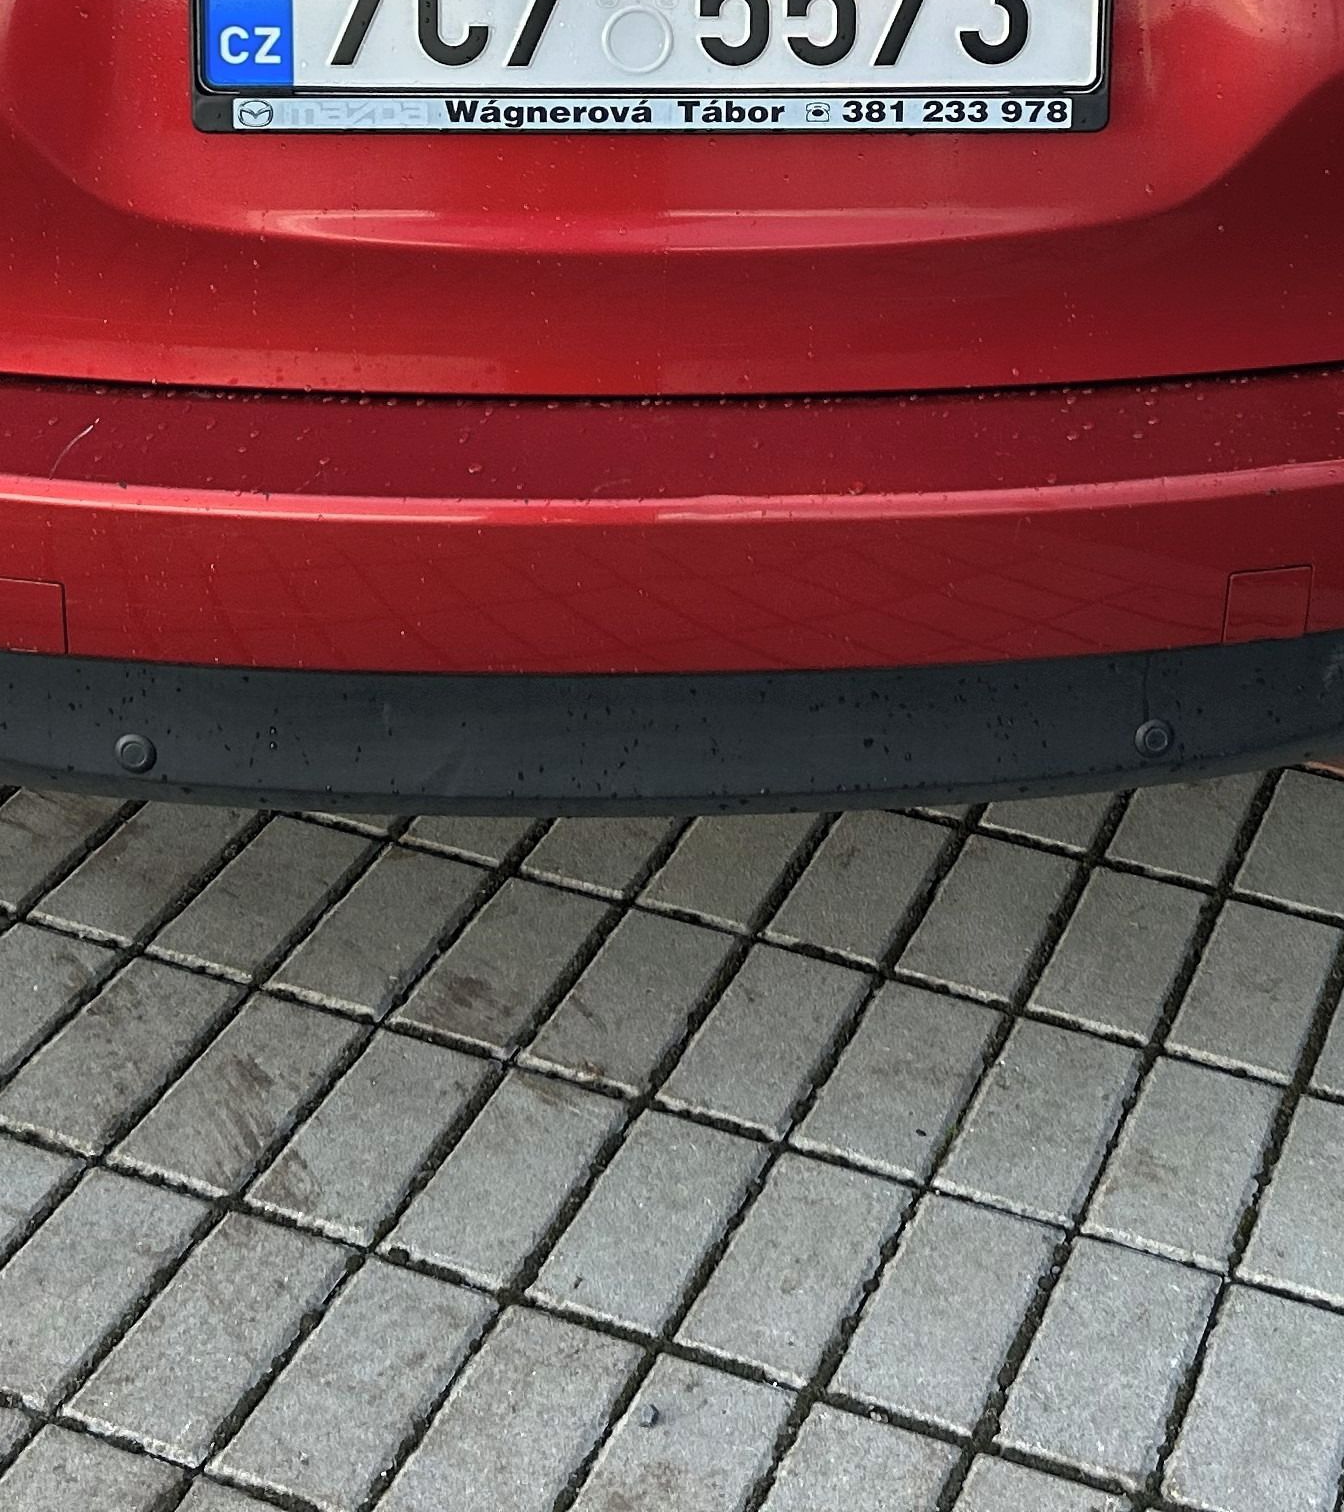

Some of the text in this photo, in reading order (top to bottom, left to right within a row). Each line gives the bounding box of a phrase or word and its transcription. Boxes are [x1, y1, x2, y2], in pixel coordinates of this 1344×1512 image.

[219, 25, 282, 65] CZ
[445, 100, 1069, 128] Wágnerová Tábor 381 233 978
